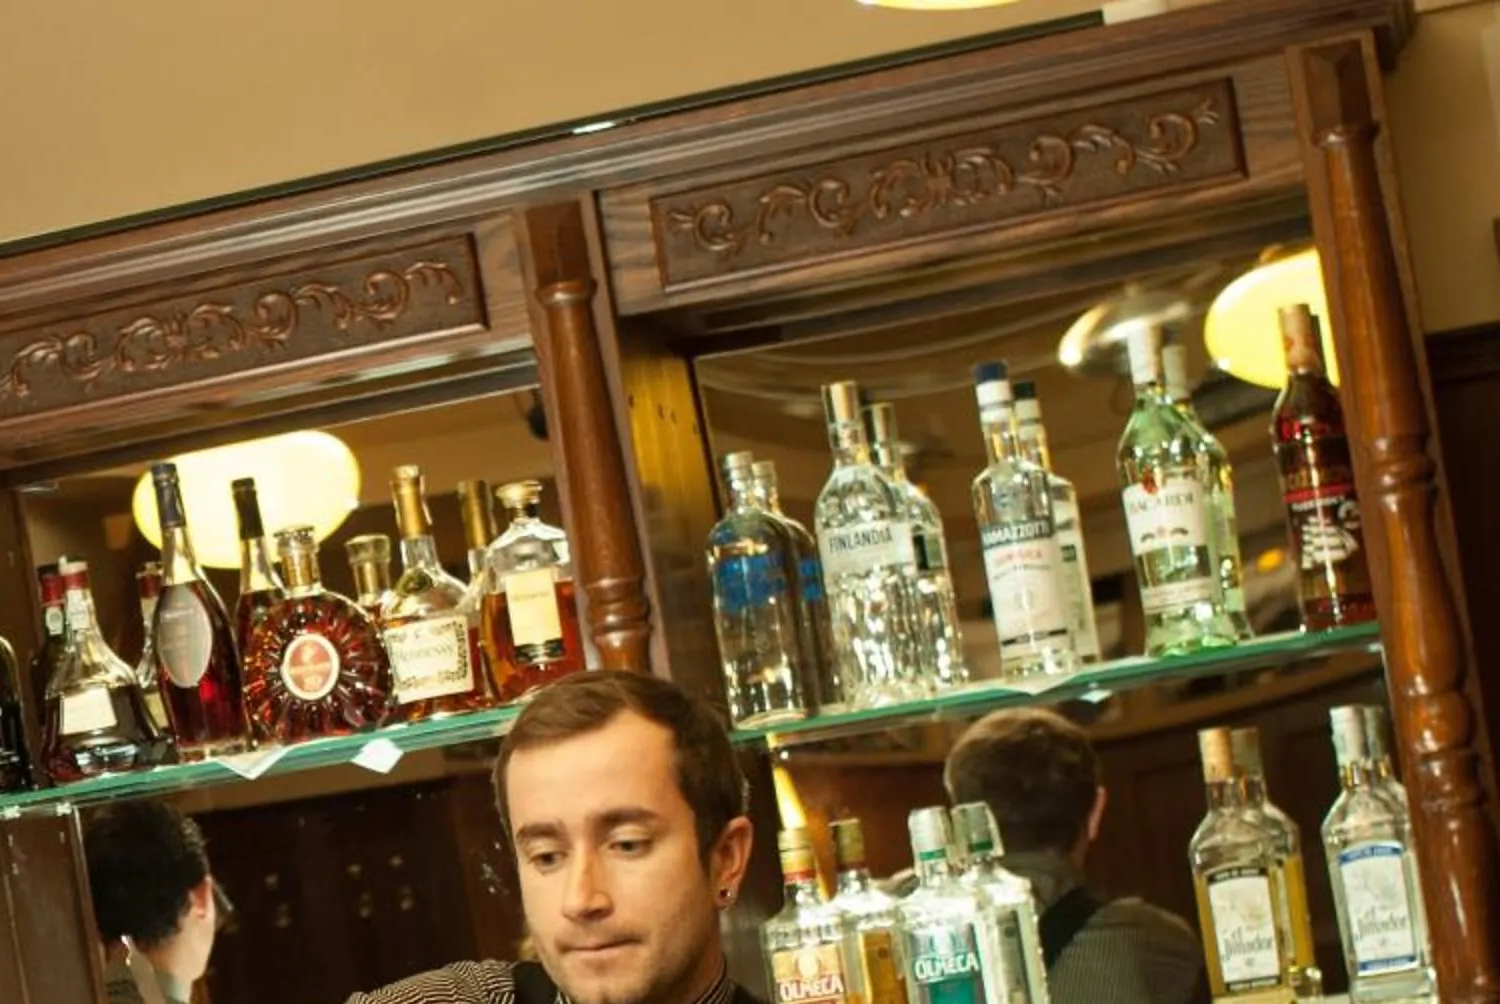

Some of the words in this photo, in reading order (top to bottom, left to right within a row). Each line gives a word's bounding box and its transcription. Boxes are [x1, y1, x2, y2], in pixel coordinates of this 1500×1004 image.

[828, 527, 892, 553] FINLANDIA
[914, 951, 980, 981] OLMECA
[780, 975, 844, 1002] OLMECA
